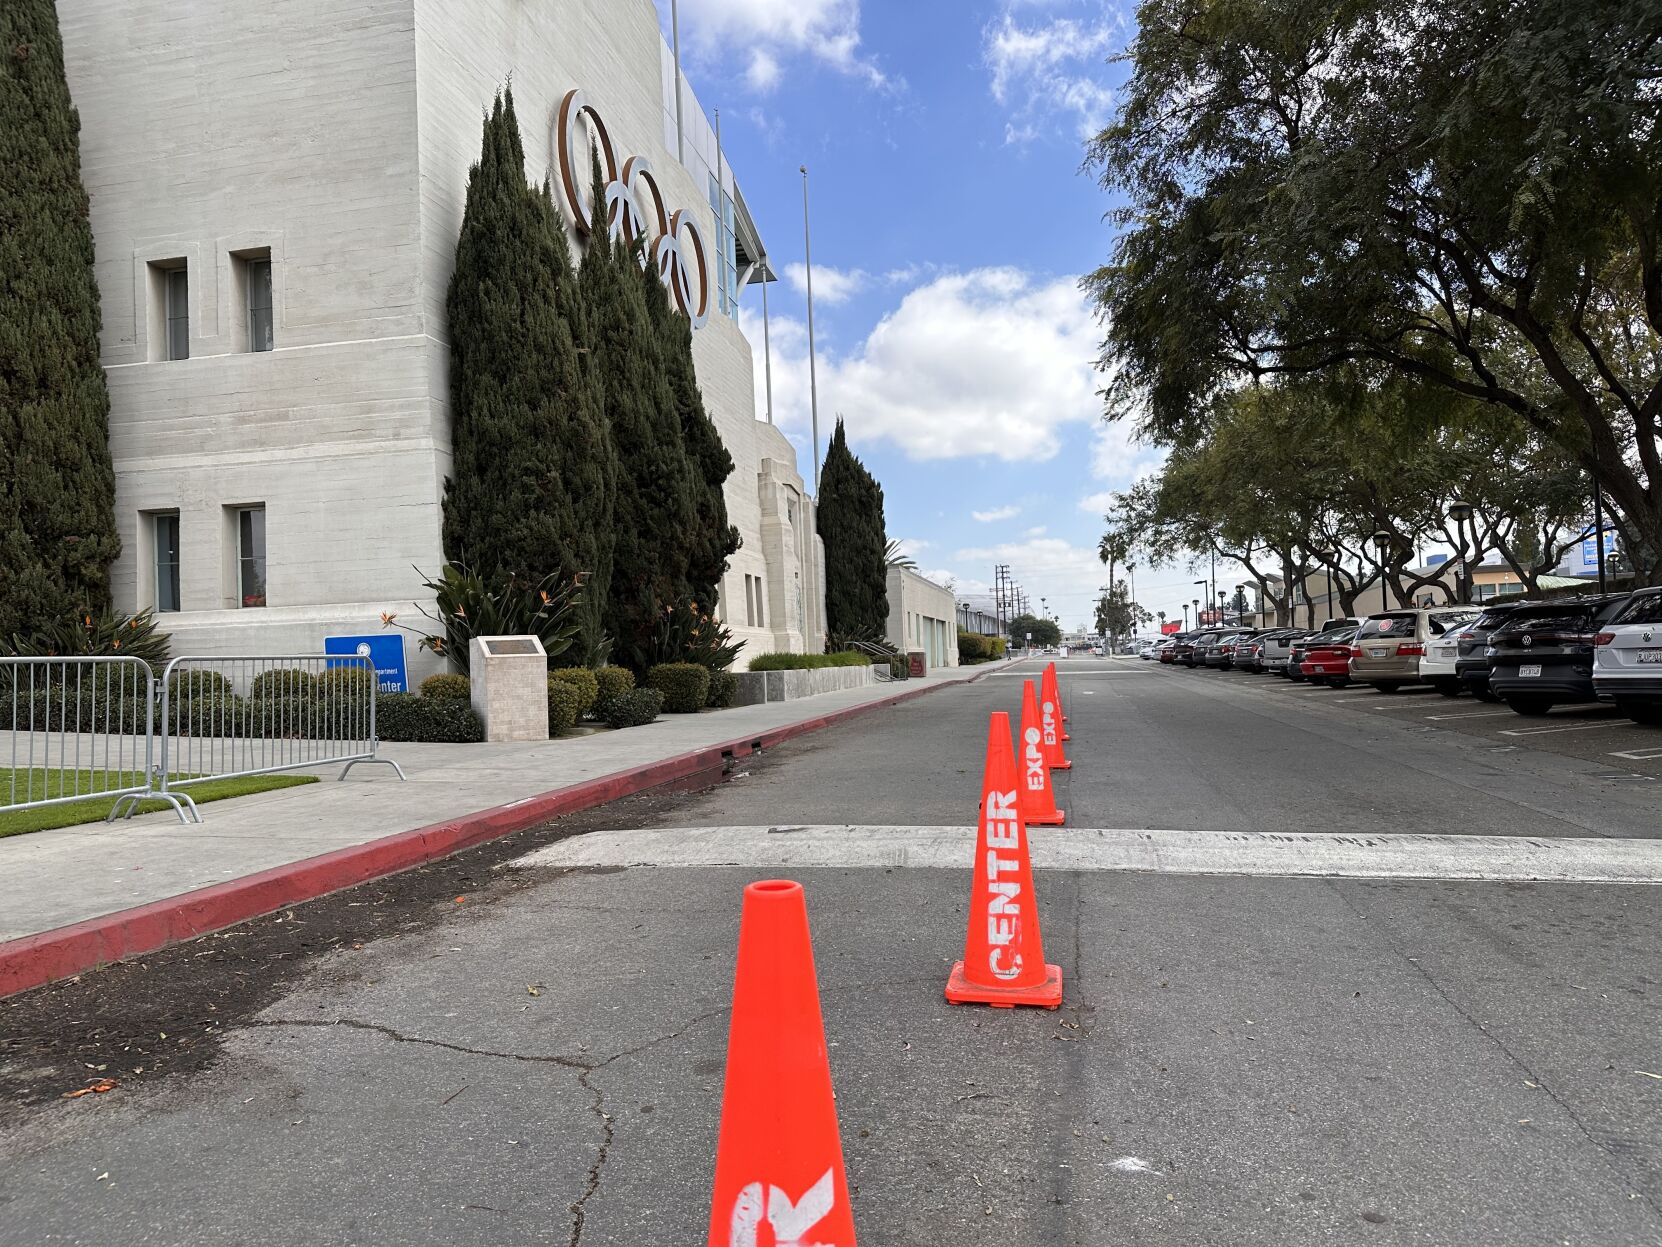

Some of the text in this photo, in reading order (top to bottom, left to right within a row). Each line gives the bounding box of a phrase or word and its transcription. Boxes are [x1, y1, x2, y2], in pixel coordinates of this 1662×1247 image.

[1042, 701, 1057, 745] EXPO
[1024, 726, 1045, 791] EXPO
[986, 789, 1023, 980] CENTER
